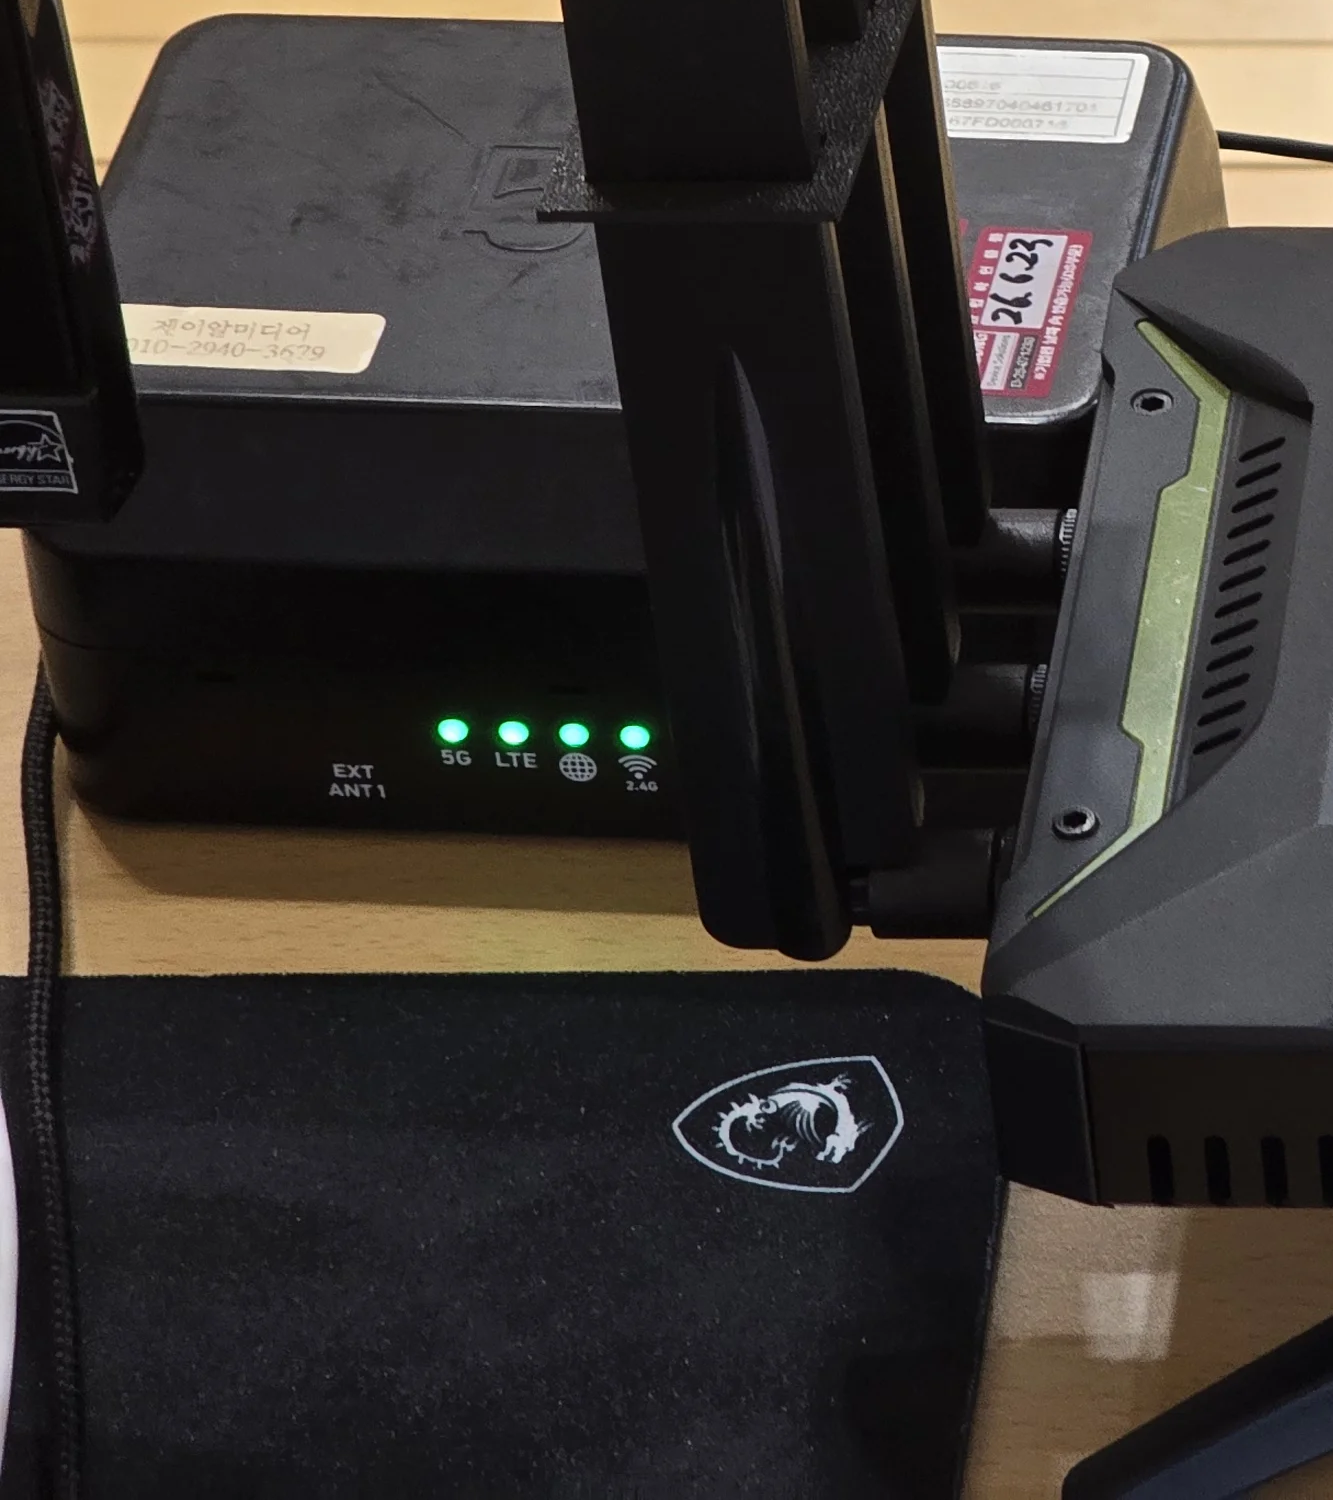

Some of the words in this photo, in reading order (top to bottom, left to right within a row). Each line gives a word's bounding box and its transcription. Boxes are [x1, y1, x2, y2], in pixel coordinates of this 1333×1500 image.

[441, 750, 472, 766] 5G
[495, 752, 538, 769] LTE
[332, 763, 374, 779] EXT
[328, 783, 373, 798] ANT
[376, 784, 387, 799] 1
[626, 781, 658, 792] 2.4G
